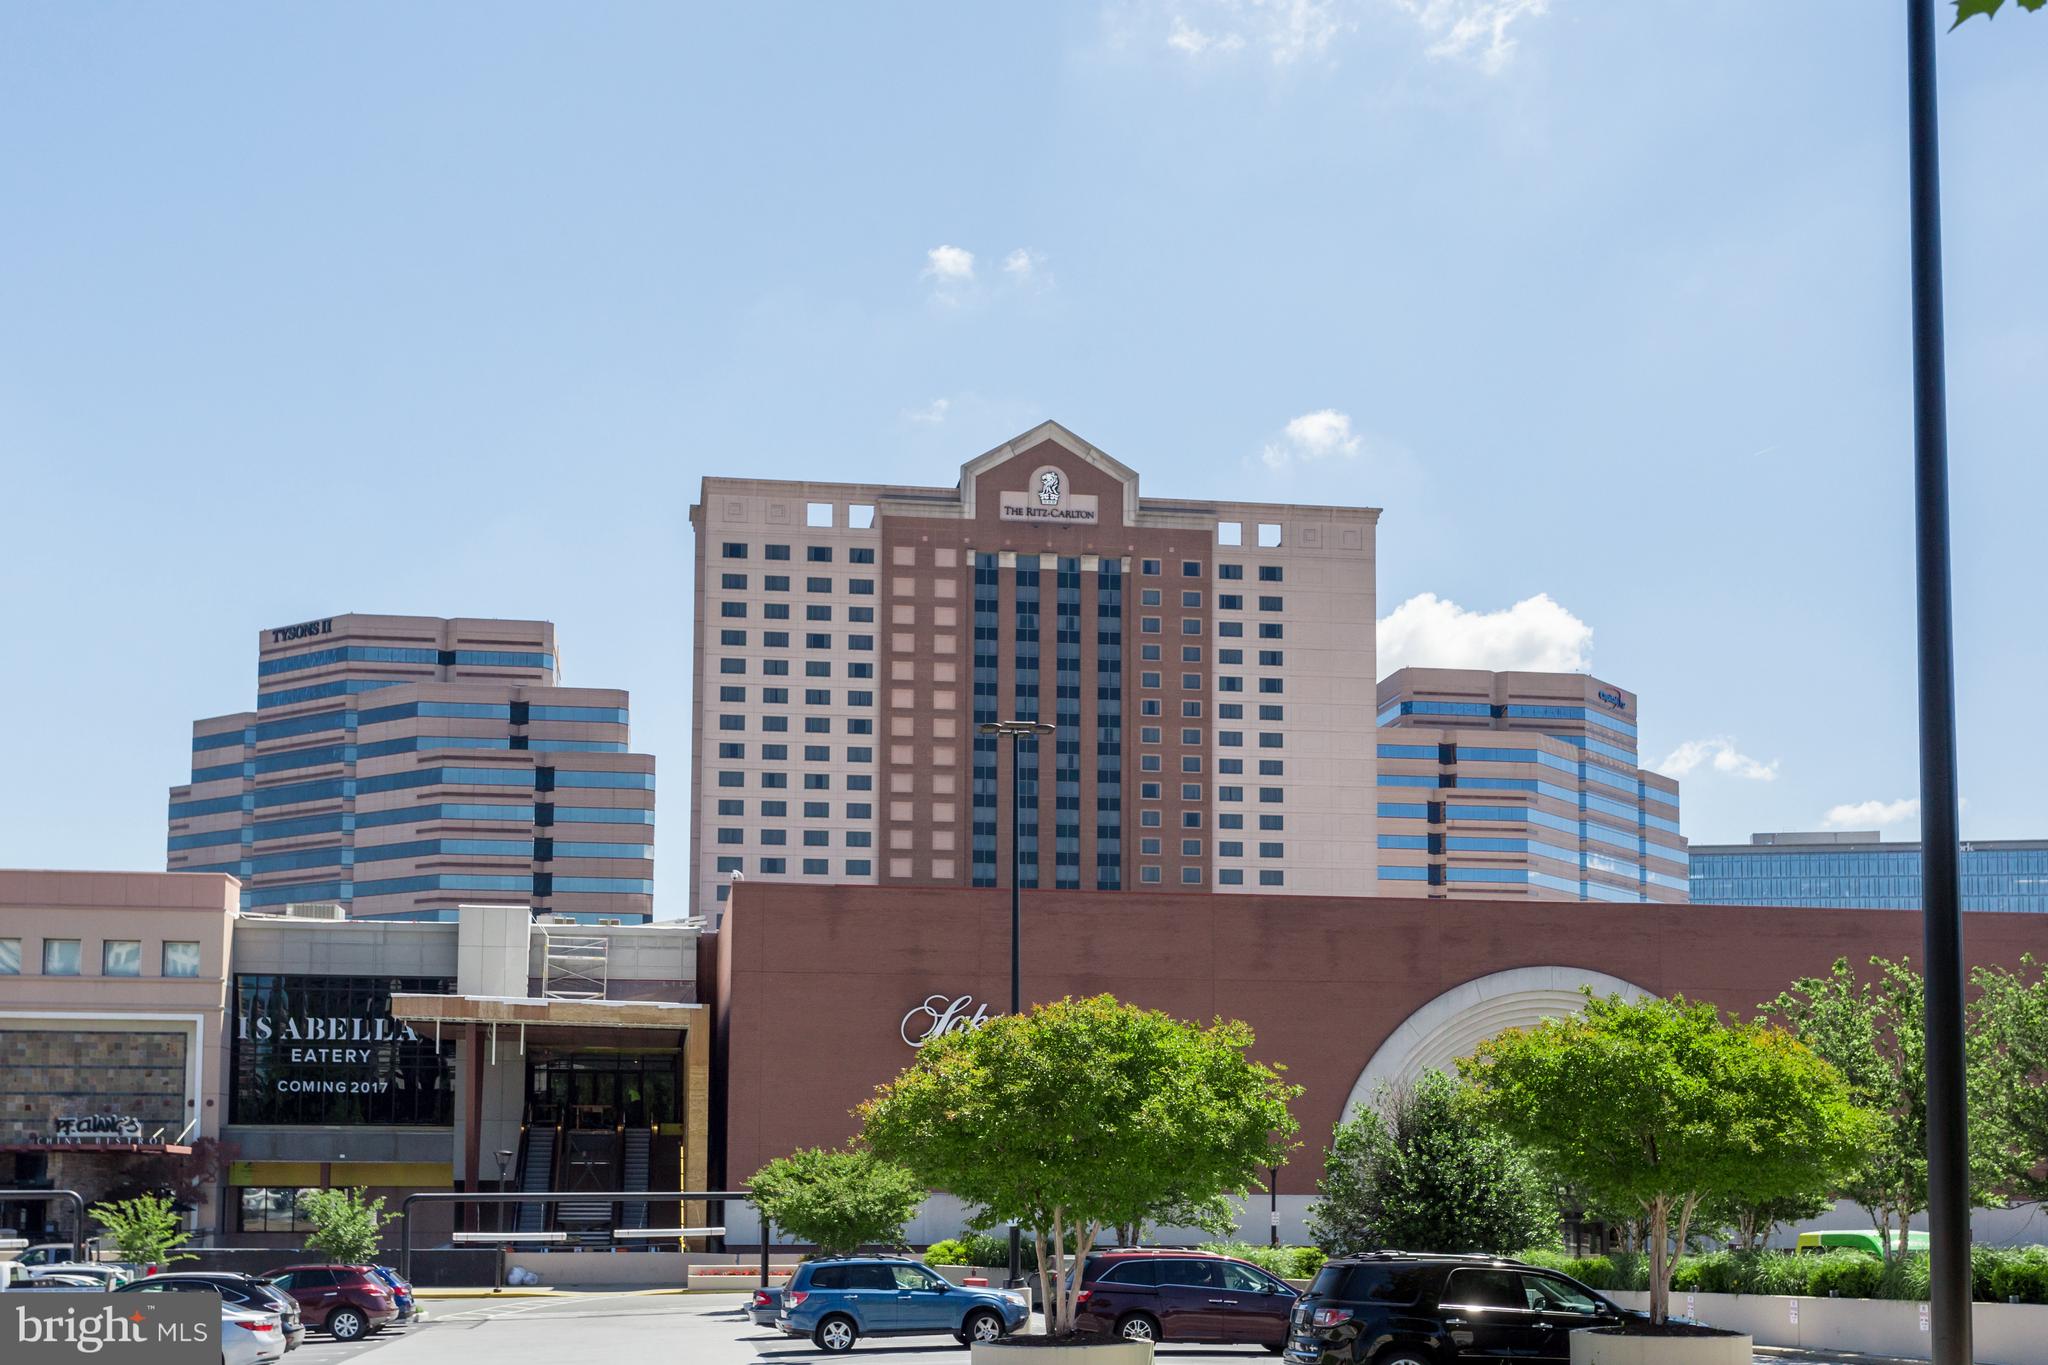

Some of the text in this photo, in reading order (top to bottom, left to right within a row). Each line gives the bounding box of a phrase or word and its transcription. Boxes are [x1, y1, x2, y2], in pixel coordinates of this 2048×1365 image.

[1004, 505, 1095, 519] THE RITZ-CARLTON
[272, 620, 320, 643] TYSONS
[901, 994, 990, 1048] Sak
[291, 1048, 371, 1063] EATERY
[277, 1080, 388, 1094] COMING 2017
[37, 1136, 158, 1145] CHINA BISTRO
